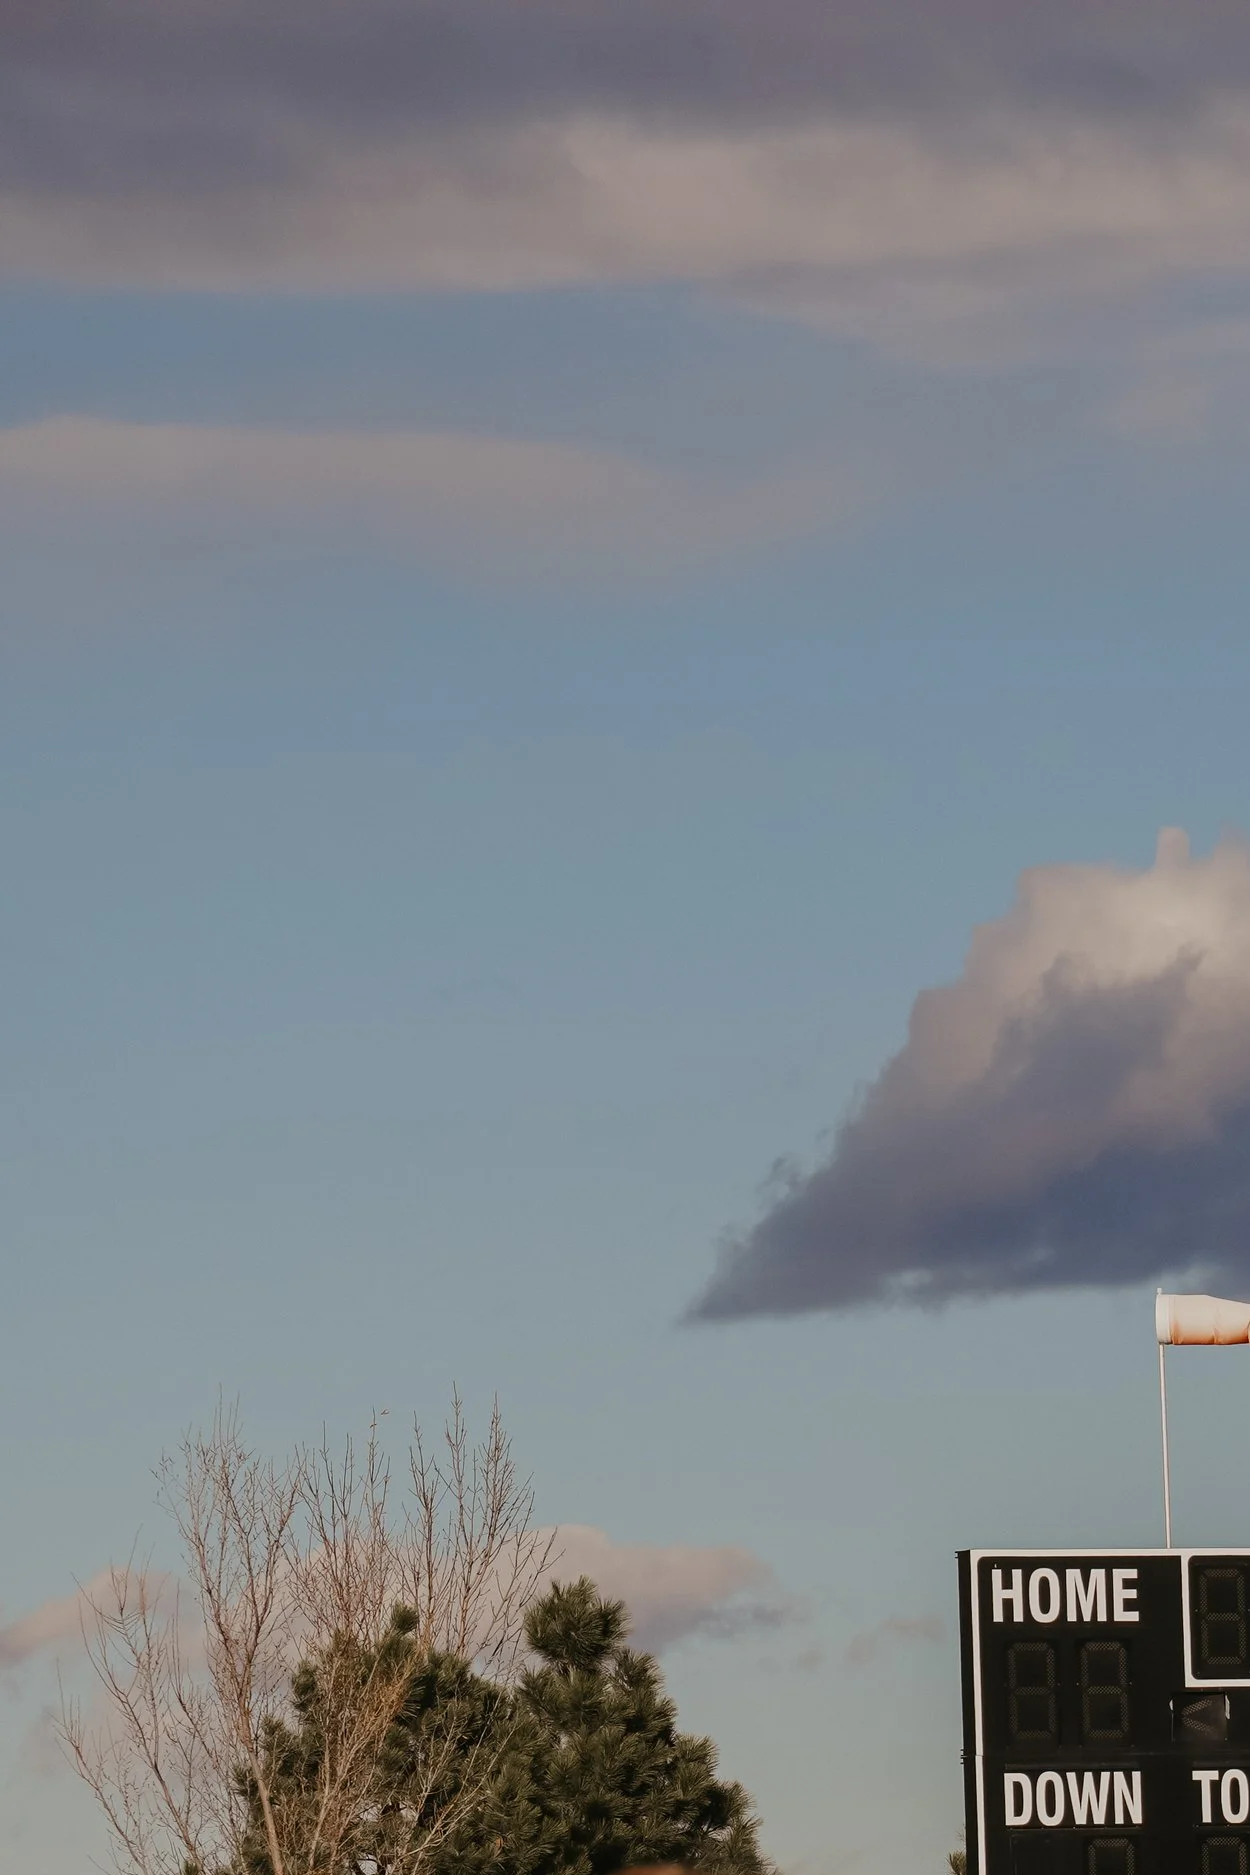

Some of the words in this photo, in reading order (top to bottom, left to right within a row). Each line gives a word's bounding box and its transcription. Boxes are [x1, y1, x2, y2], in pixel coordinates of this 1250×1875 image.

[991, 1567, 1140, 1624] HOME
[1003, 1770, 1143, 1827] DOWN
[1191, 1768, 1250, 1824] TO
